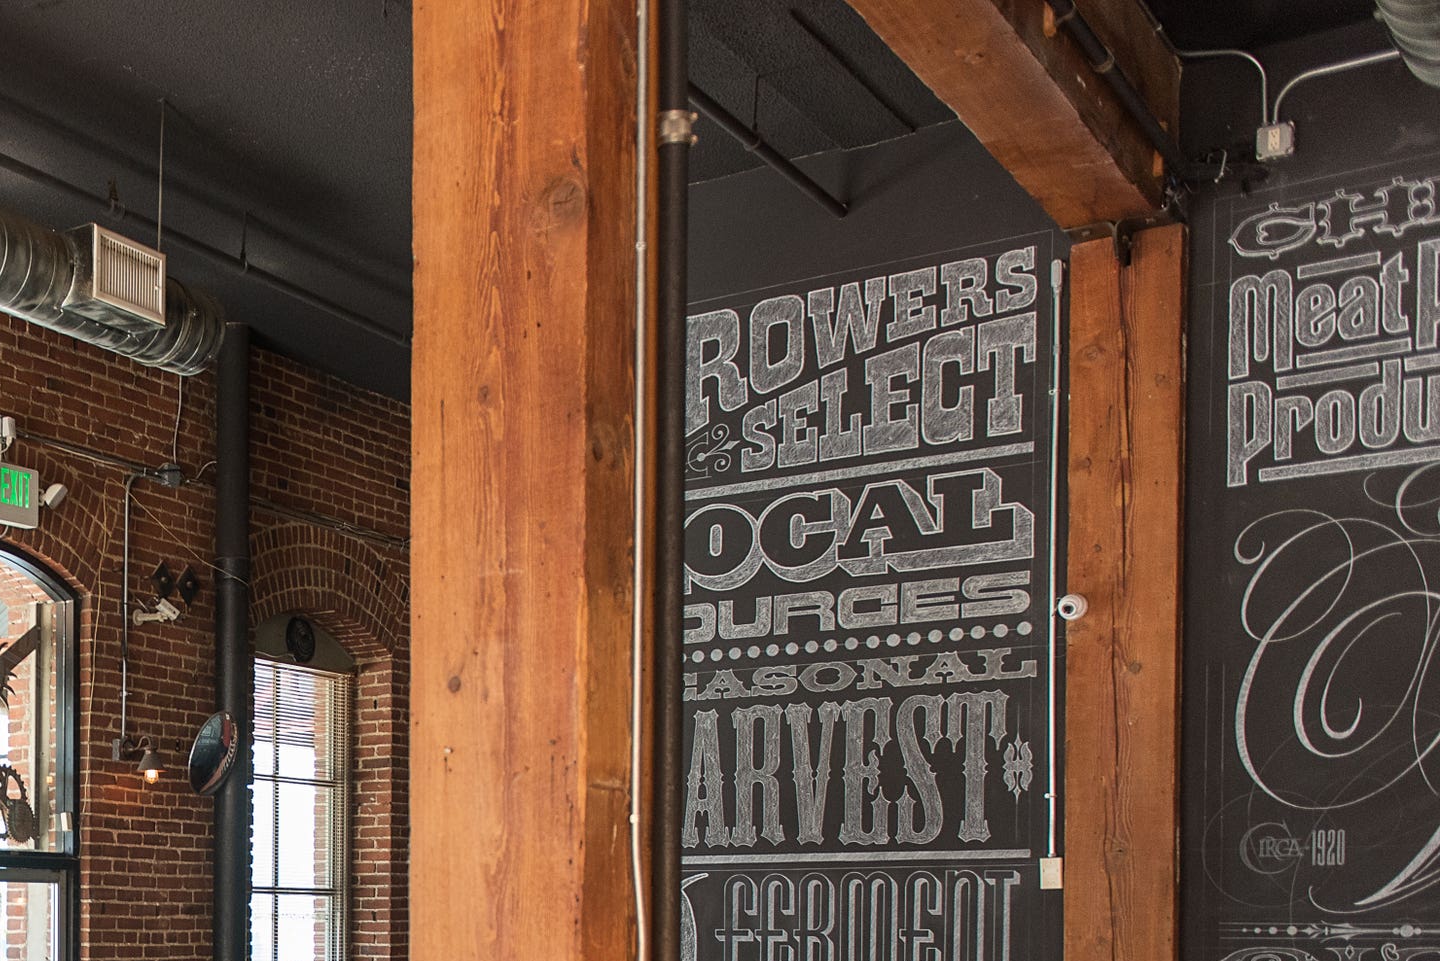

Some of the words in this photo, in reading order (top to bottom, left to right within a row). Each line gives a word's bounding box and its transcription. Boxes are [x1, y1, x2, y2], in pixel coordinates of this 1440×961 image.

[686, 246, 1038, 436] ROWERS
[1228, 250, 1410, 380] Meat
[741, 311, 1037, 473] SELECT
[0, 467, 33, 508] EXIT
[684, 467, 1035, 594] OCAL
[684, 570, 1031, 645] OURCES
[683, 648, 1037, 702] ASONAL
[681, 690, 1010, 849] ARVEST
[1311, 829, 1346, 866] 1920
